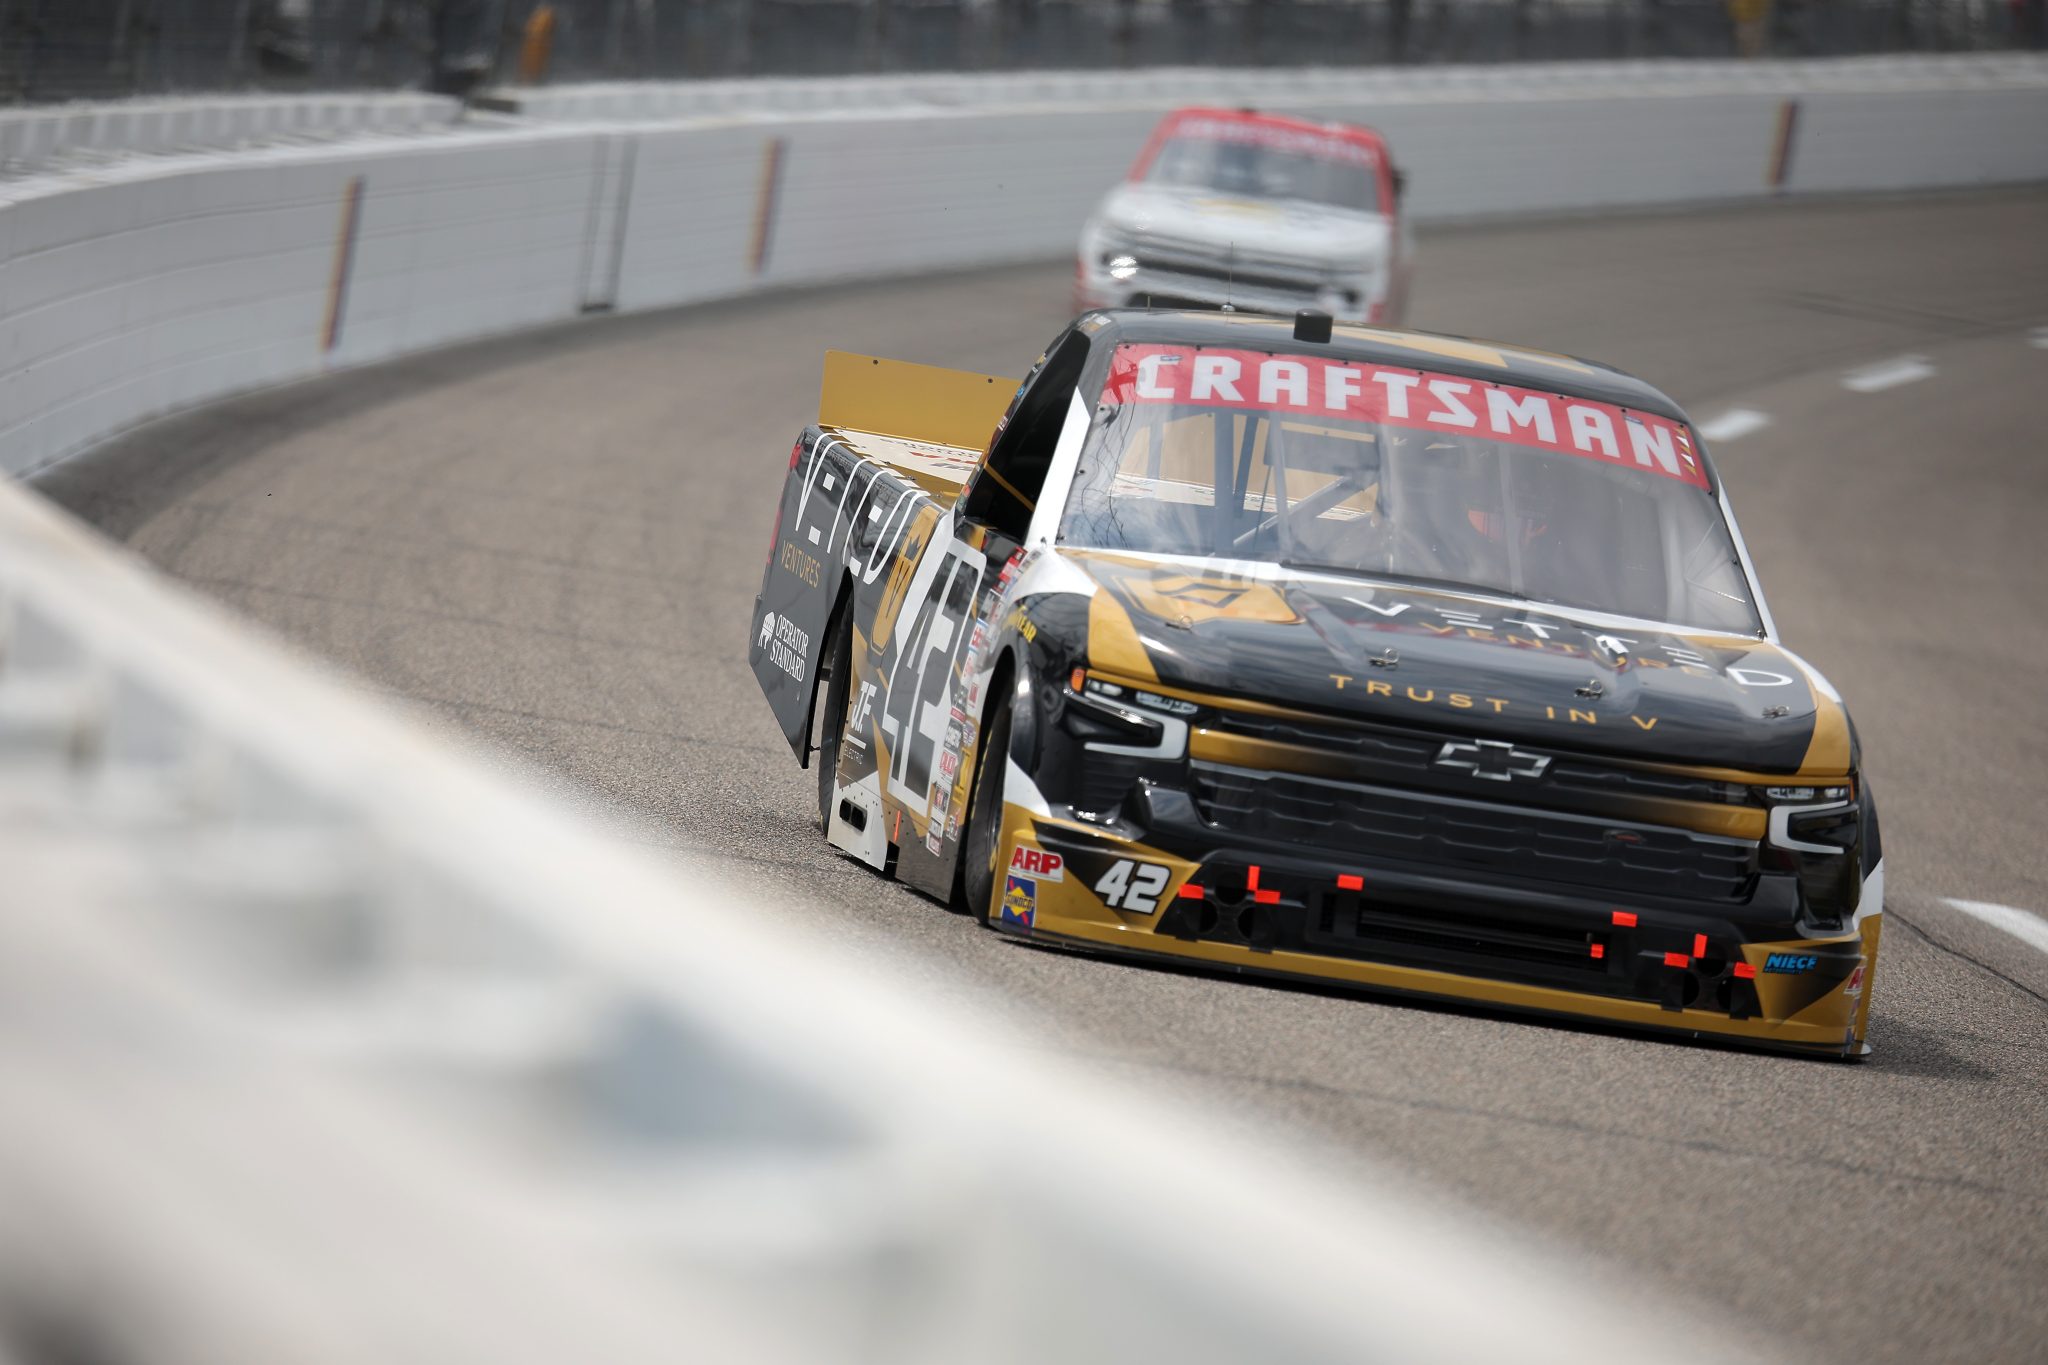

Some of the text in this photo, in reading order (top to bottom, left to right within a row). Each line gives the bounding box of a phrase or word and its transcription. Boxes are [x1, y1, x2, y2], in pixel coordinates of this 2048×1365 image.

[1136, 354, 1683, 476] CRAFTSMAN
[781, 539, 821, 588] VENTURES
[770, 639, 806, 682] STANDARD
[775, 614, 809, 658] OPERATOR
[1342, 597, 1794, 687] VETTED
[1420, 620, 1748, 695] VENTURE
[1329, 674, 1659, 731] TRUST IN V
[1011, 847, 1061, 874] ARP
[1006, 893, 1034, 911] SUNOCO
[1095, 859, 1171, 914] 42
[1766, 953, 1818, 970] NIECE
